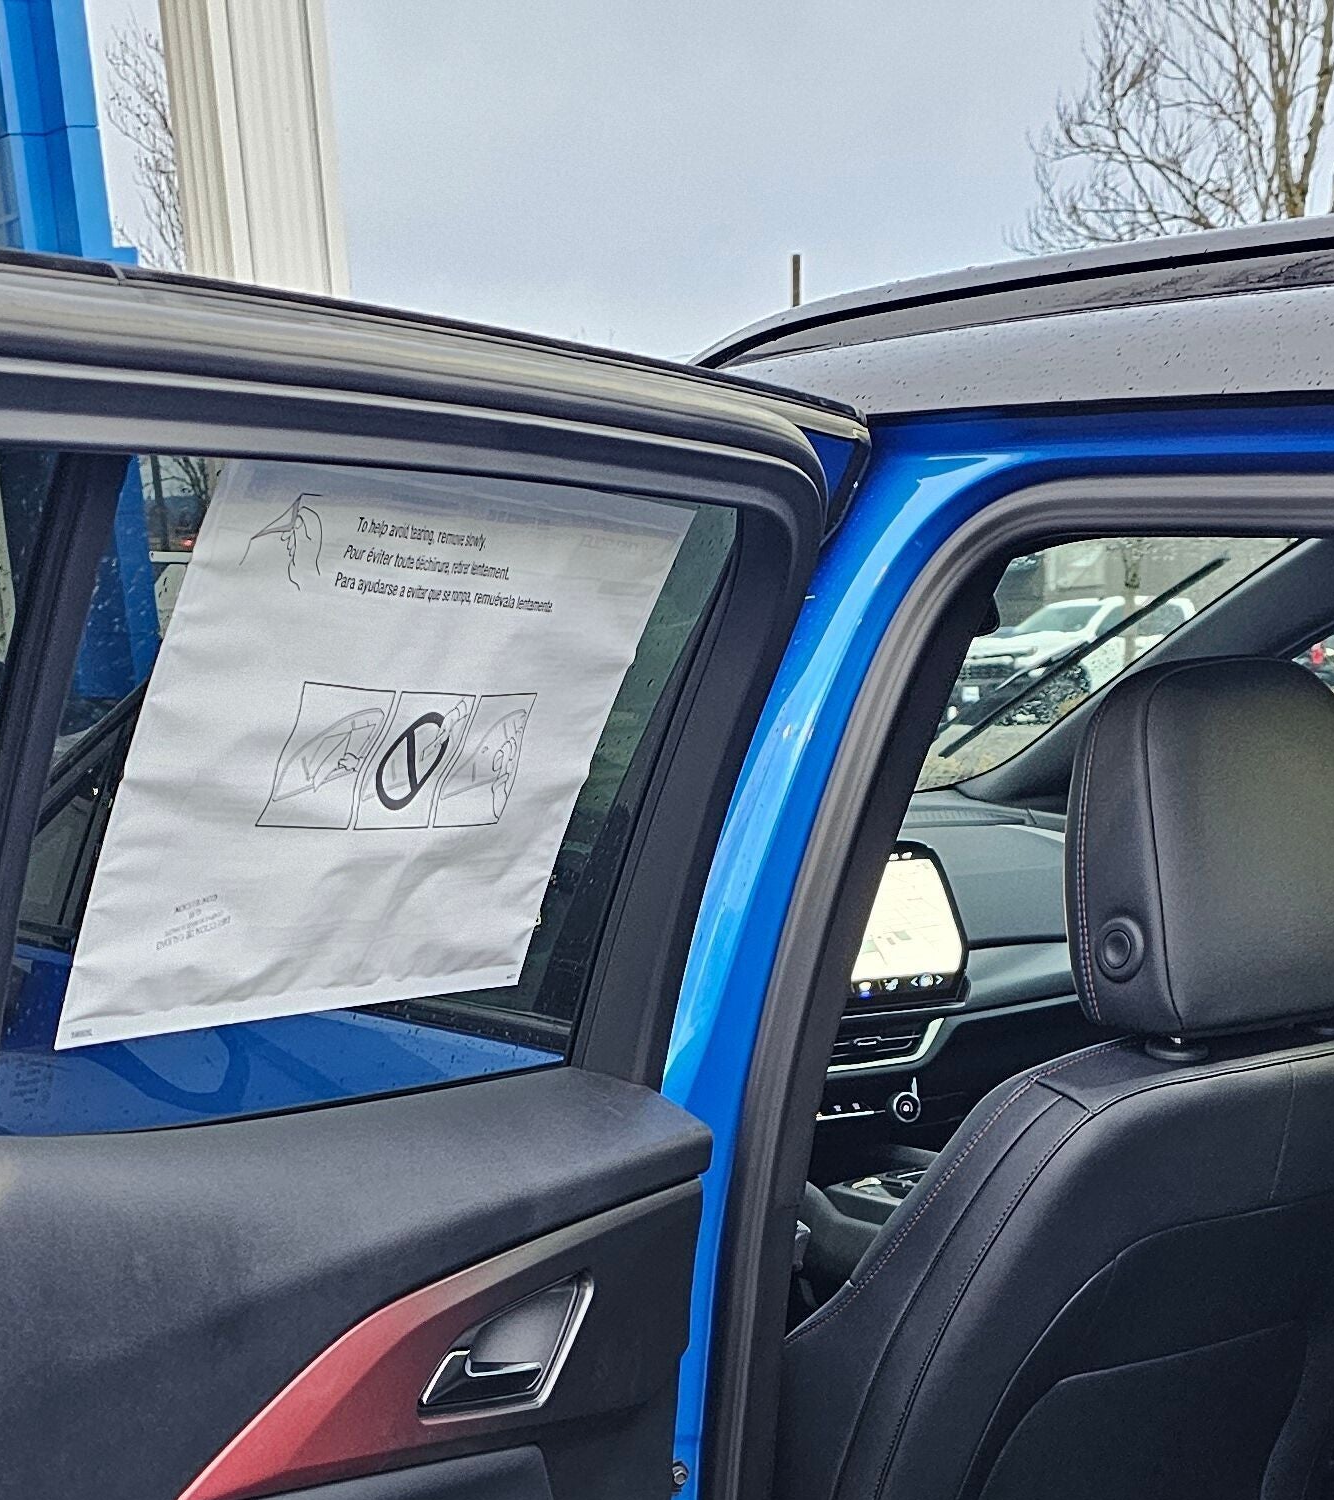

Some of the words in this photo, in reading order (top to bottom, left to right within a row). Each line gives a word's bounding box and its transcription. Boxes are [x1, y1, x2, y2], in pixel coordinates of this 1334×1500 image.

[357, 516, 369, 533] To
[368, 519, 389, 539] help
[389, 524, 410, 539] avoid
[410, 525, 435, 546] tearing,
[437, 532, 464, 546] remove
[465, 532, 486, 552] slowly.
[343, 544, 366, 560] Pour
[366, 546, 394, 566] éviter
[394, 553, 415, 570] toute
[334, 571, 356, 590] Para
[357, 578, 399, 596] ayudarse
[398, 585, 406, 598] a
[406, 585, 428, 600] evitar
[428, 588, 442, 603] que
[442, 589, 452, 602] se
[472, 591, 516, 609] remuévala
